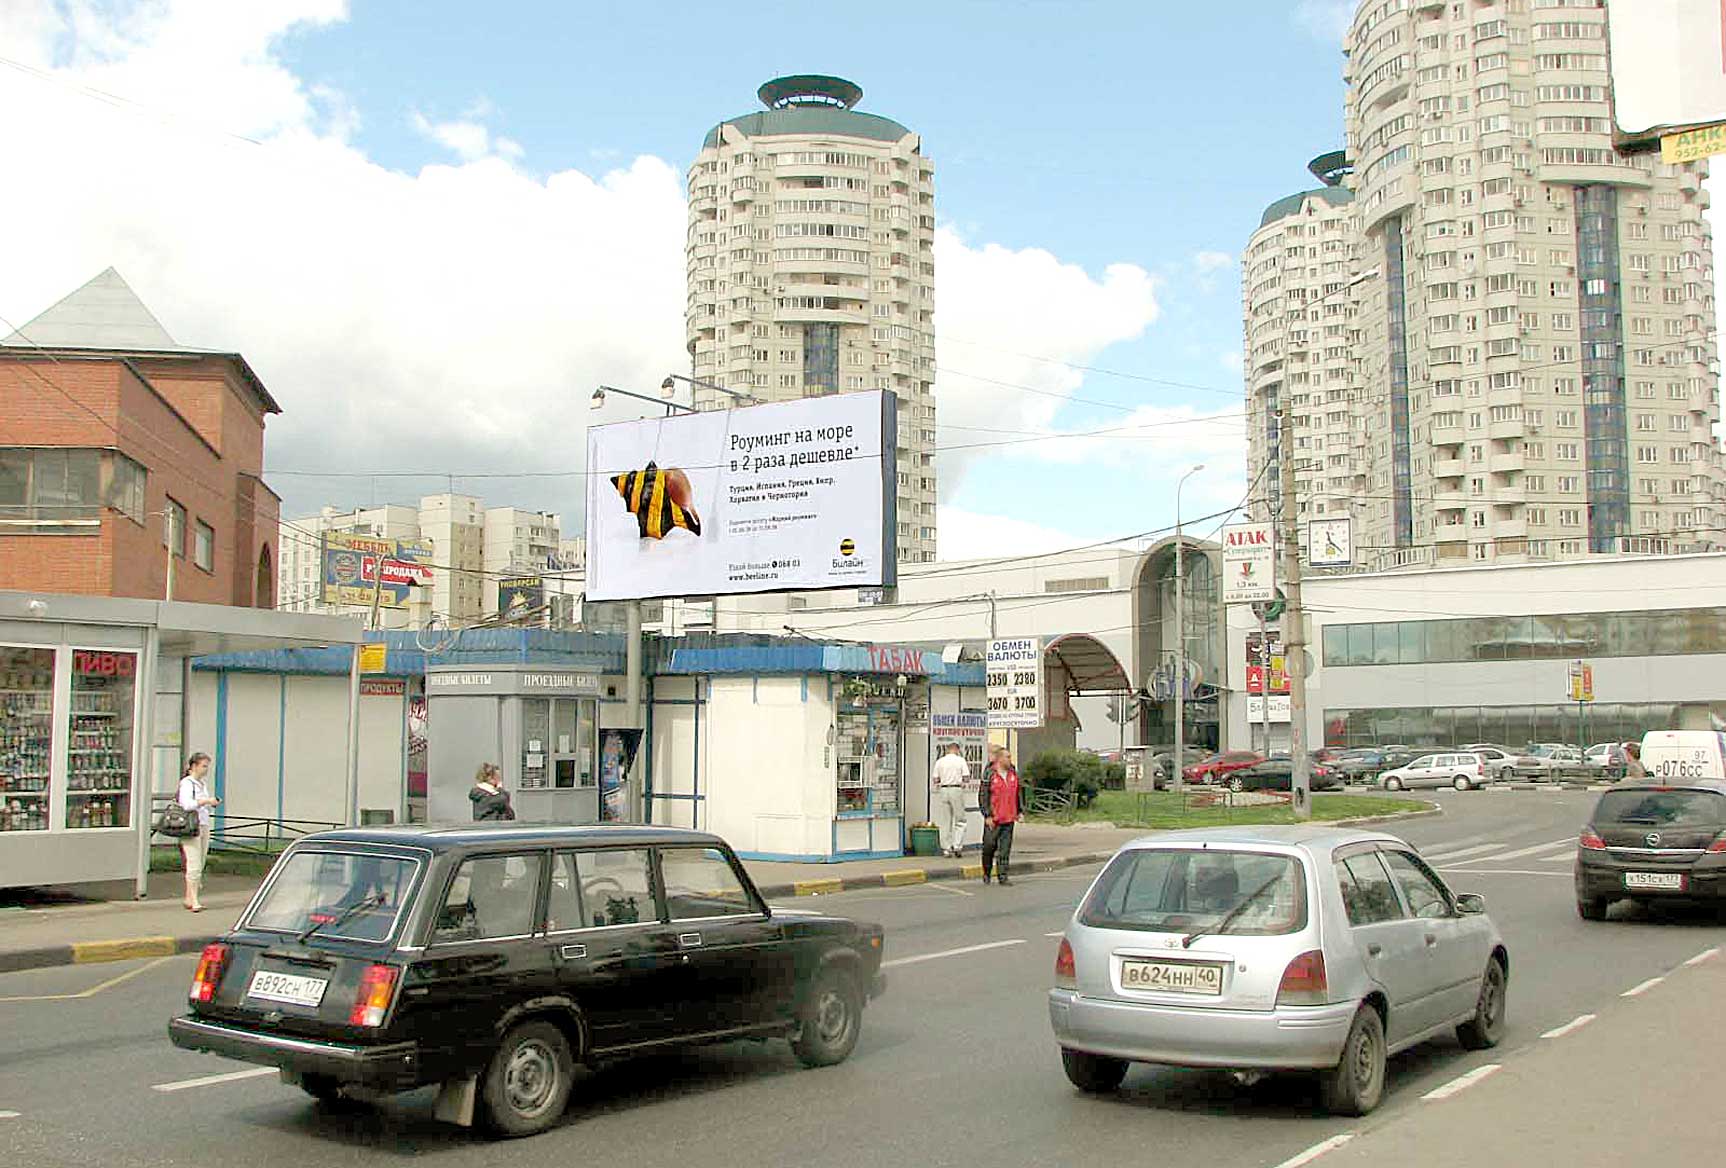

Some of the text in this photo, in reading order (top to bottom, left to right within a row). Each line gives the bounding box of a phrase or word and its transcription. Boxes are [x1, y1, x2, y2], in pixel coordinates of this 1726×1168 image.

[1676, 126, 1726, 147] АНК
[730, 425, 853, 453] Роуминг на море
[730, 460, 738, 472] в
[742, 455, 750, 471] 2
[754, 454, 785, 474] раза
[1225, 530, 1268, 546] АТАК
[366, 563, 424, 579] РПРОДАЖА
[832, 557, 864, 569] Билайн
[728, 572, 779, 581] www.beeline.ru
[993, 641, 1031, 651] ОБМЕН
[75, 652, 133, 676] ПИВО
[867, 644, 927, 674] ТАБАК
[987, 650, 1037, 662] ВАЛЮТЫ
[987, 672, 1036, 687] 2350 2380
[360, 683, 404, 694] ПРОДУКТЫ
[987, 696, 1036, 711] 3670 3700
[1694, 750, 1706, 760] 97
[1655, 759, 1702, 777] Р076СС
[1128, 965, 1215, 986] В624НН 40
[254, 975, 324, 995] В892СН 177
